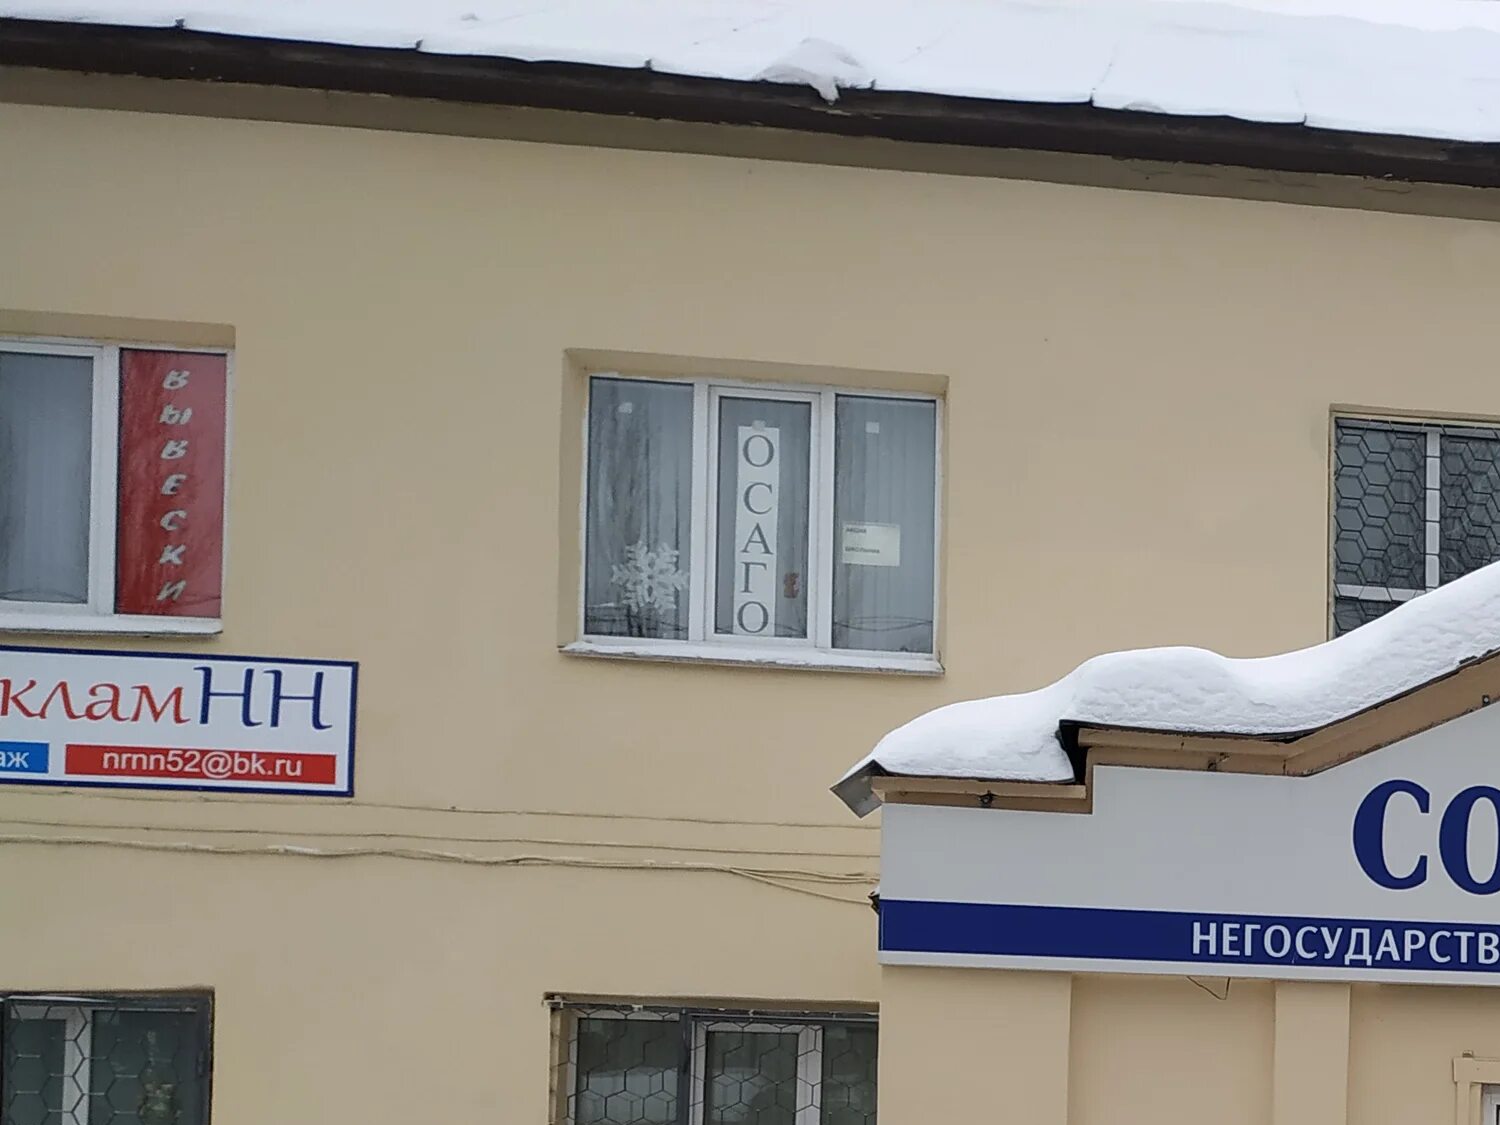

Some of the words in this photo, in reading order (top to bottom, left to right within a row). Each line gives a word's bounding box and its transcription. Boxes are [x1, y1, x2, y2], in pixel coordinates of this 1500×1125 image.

[157, 369, 193, 601] ВЫВЕСКИ
[736, 434, 775, 634] ОСАГО
[102, 750, 303, 779] nrnn52@bk.ru
